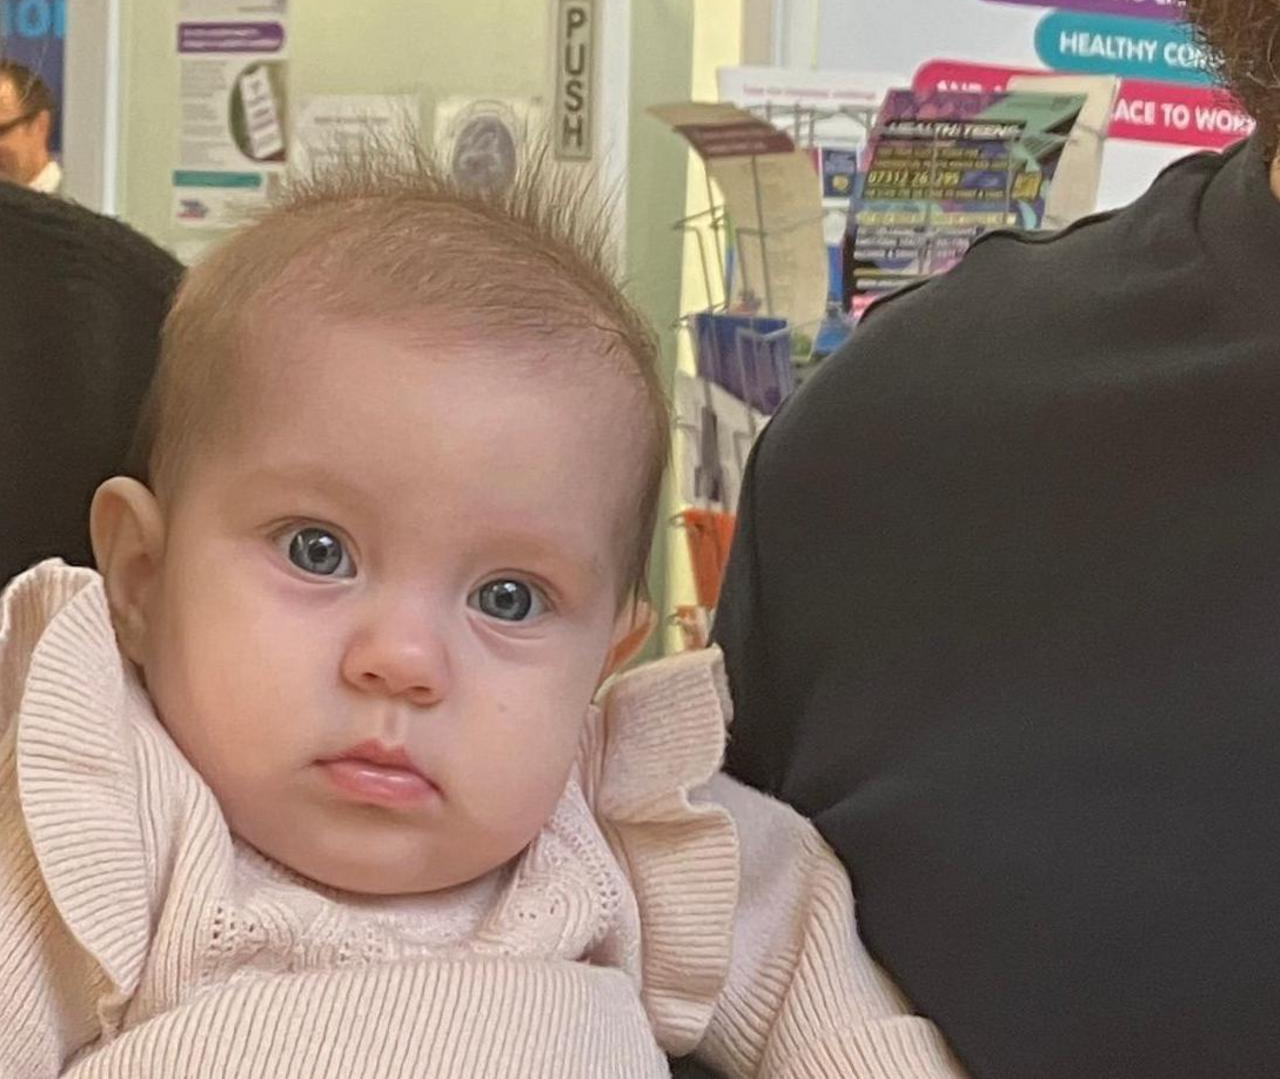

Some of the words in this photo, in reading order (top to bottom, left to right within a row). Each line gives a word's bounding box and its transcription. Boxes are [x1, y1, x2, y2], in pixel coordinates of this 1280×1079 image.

[1059, 30, 1159, 65] HEALTHY
[561, 6, 588, 151] PUSH
[1160, 102, 1191, 131] TO
